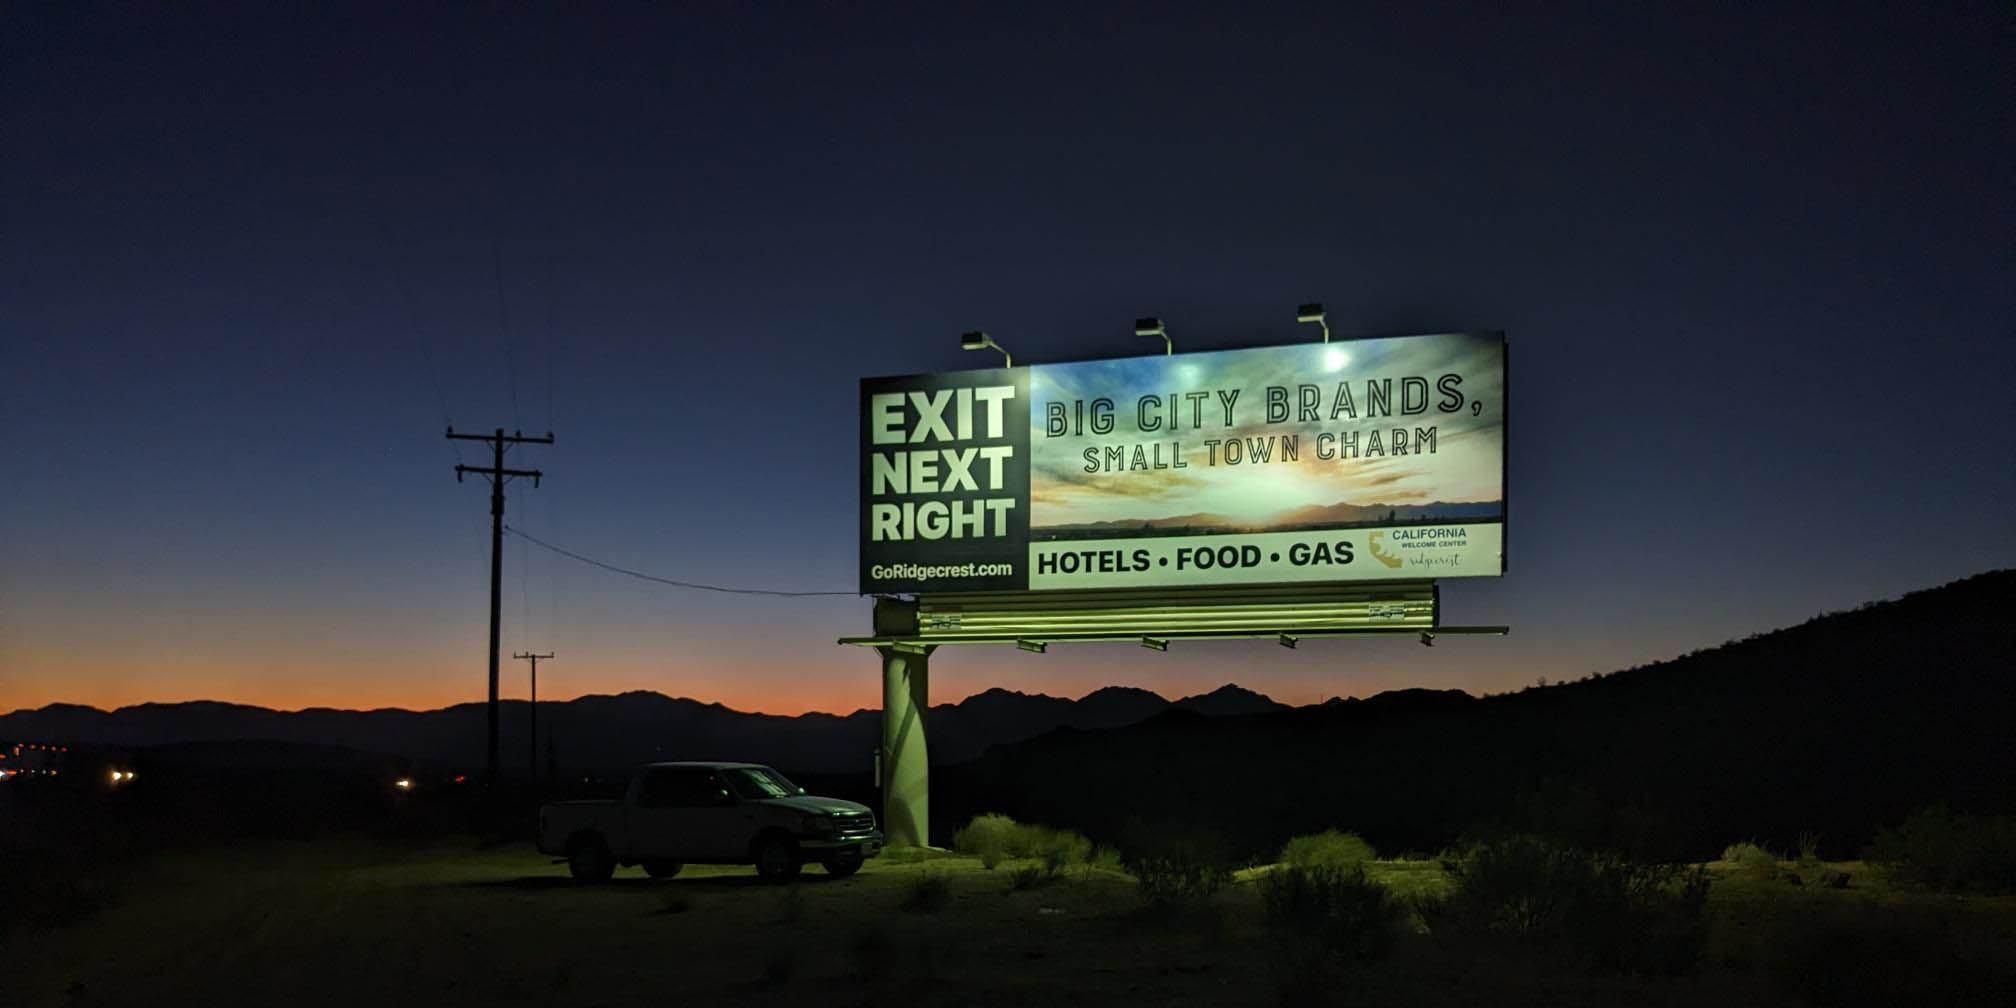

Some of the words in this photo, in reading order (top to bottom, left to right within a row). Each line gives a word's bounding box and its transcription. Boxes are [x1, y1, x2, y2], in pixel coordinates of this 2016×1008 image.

[872, 385, 1015, 444] EXIT
[1046, 397, 1115, 438] BIG
[1137, 389, 1240, 432] CITY
[1266, 373, 1482, 424] BRANDS,
[872, 446, 1013, 495] NEXT
[1083, 441, 1187, 473] SMALL
[1204, 435, 1299, 467] TOWN
[1316, 426, 1437, 460] CHARM
[872, 498, 1016, 541] RIGHT
[1392, 528, 1467, 540] CALIFORNIA
[1038, 549, 1150, 574] HOTELS
[1176, 545, 1262, 570] FOOD
[1288, 541, 1355, 566] GAS
[1401, 541, 1436, 549] WELCOME
[1438, 540, 1467, 548] CENTER
[871, 562, 1013, 581] GoRidgecrest.com
